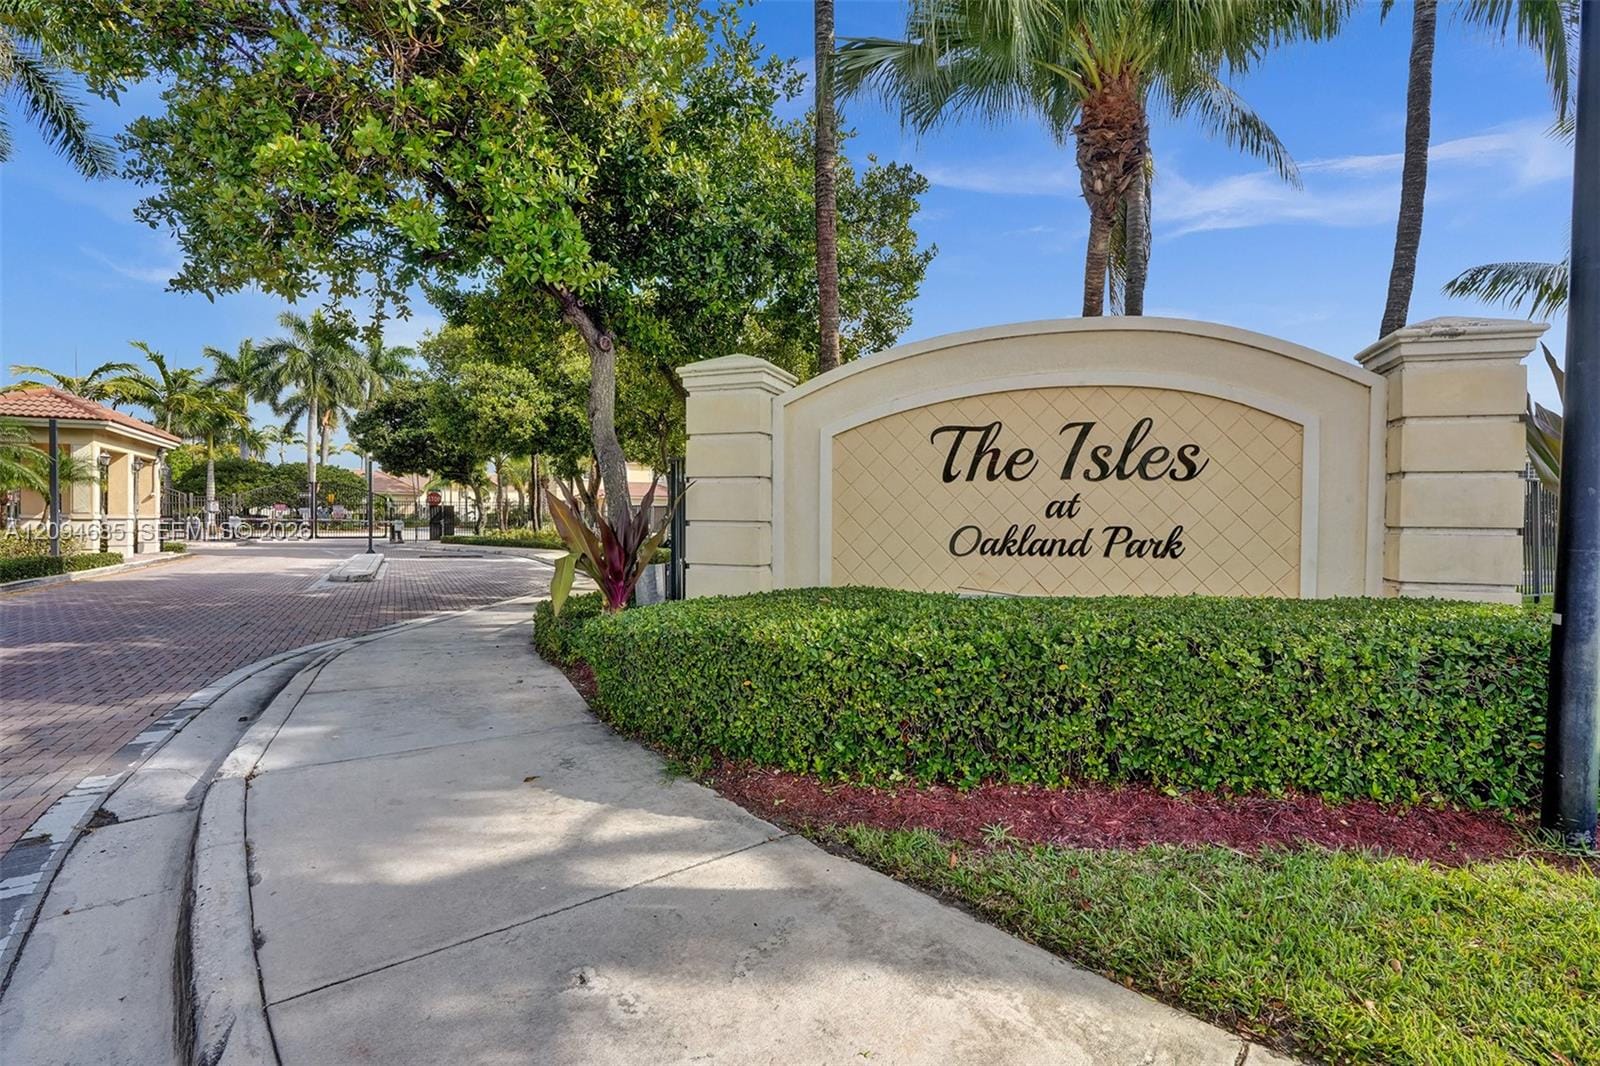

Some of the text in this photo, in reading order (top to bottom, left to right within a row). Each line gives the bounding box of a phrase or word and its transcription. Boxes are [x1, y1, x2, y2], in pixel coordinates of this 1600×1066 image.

[930, 417, 1210, 484] The Isles
[1045, 492, 1081, 519] at
[949, 524, 1186, 560] Oakland Park
